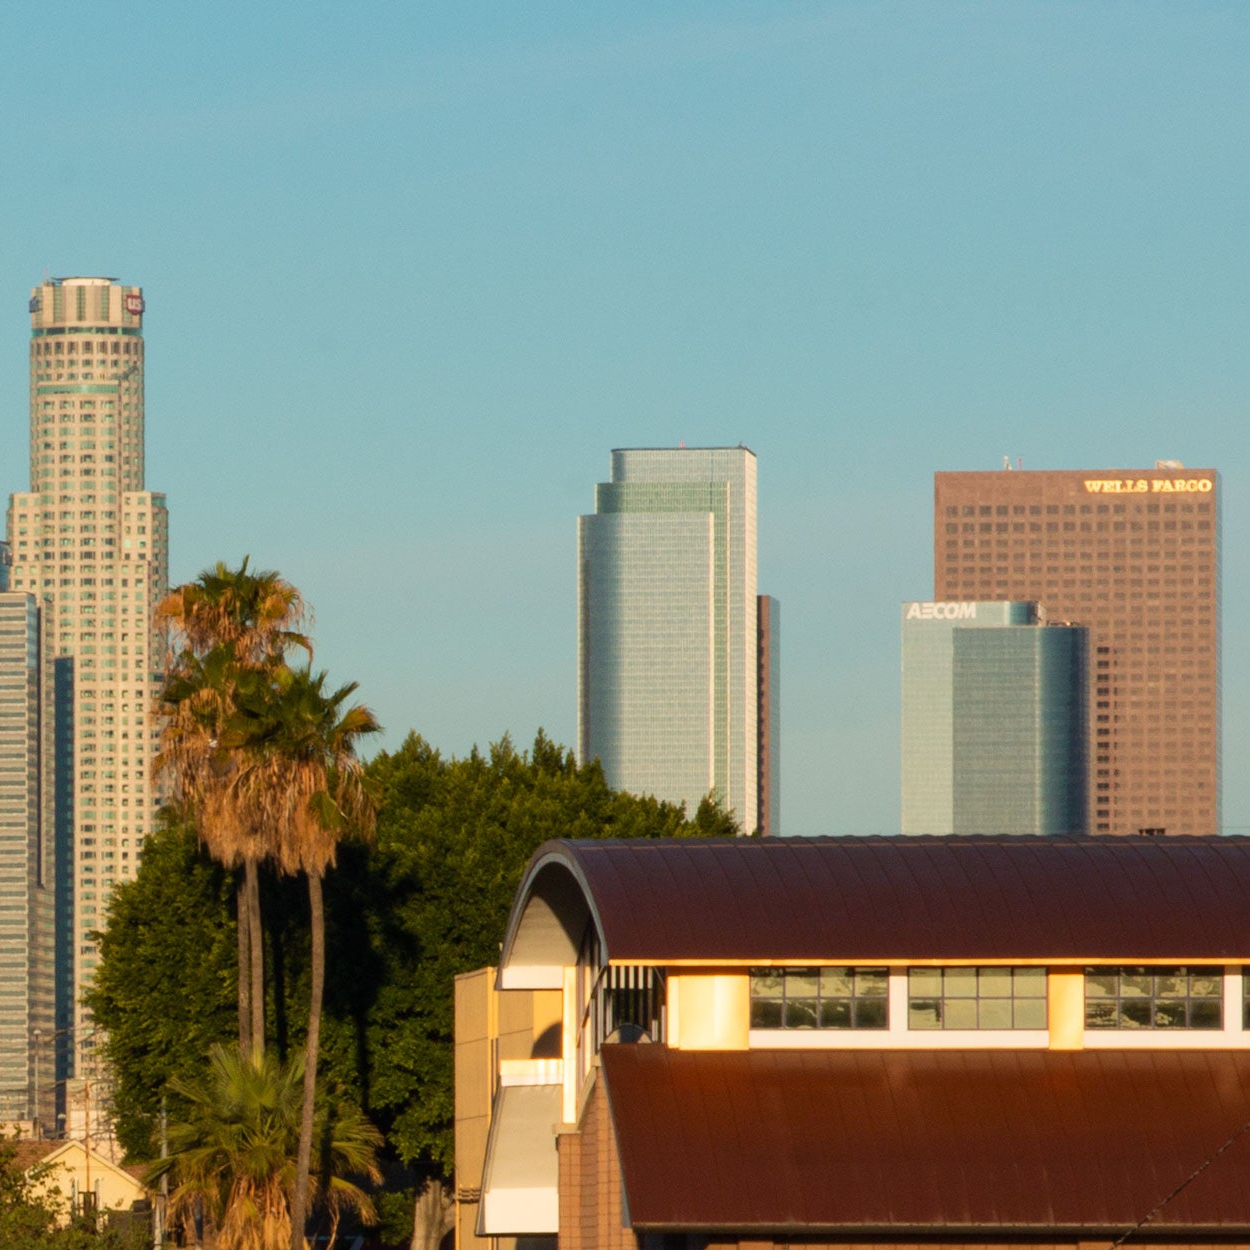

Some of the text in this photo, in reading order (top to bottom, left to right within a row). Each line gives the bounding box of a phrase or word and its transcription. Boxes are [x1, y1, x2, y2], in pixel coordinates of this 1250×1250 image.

[1084, 479, 1212, 493] WELLS FARGO
[906, 602, 976, 619] AECOM
